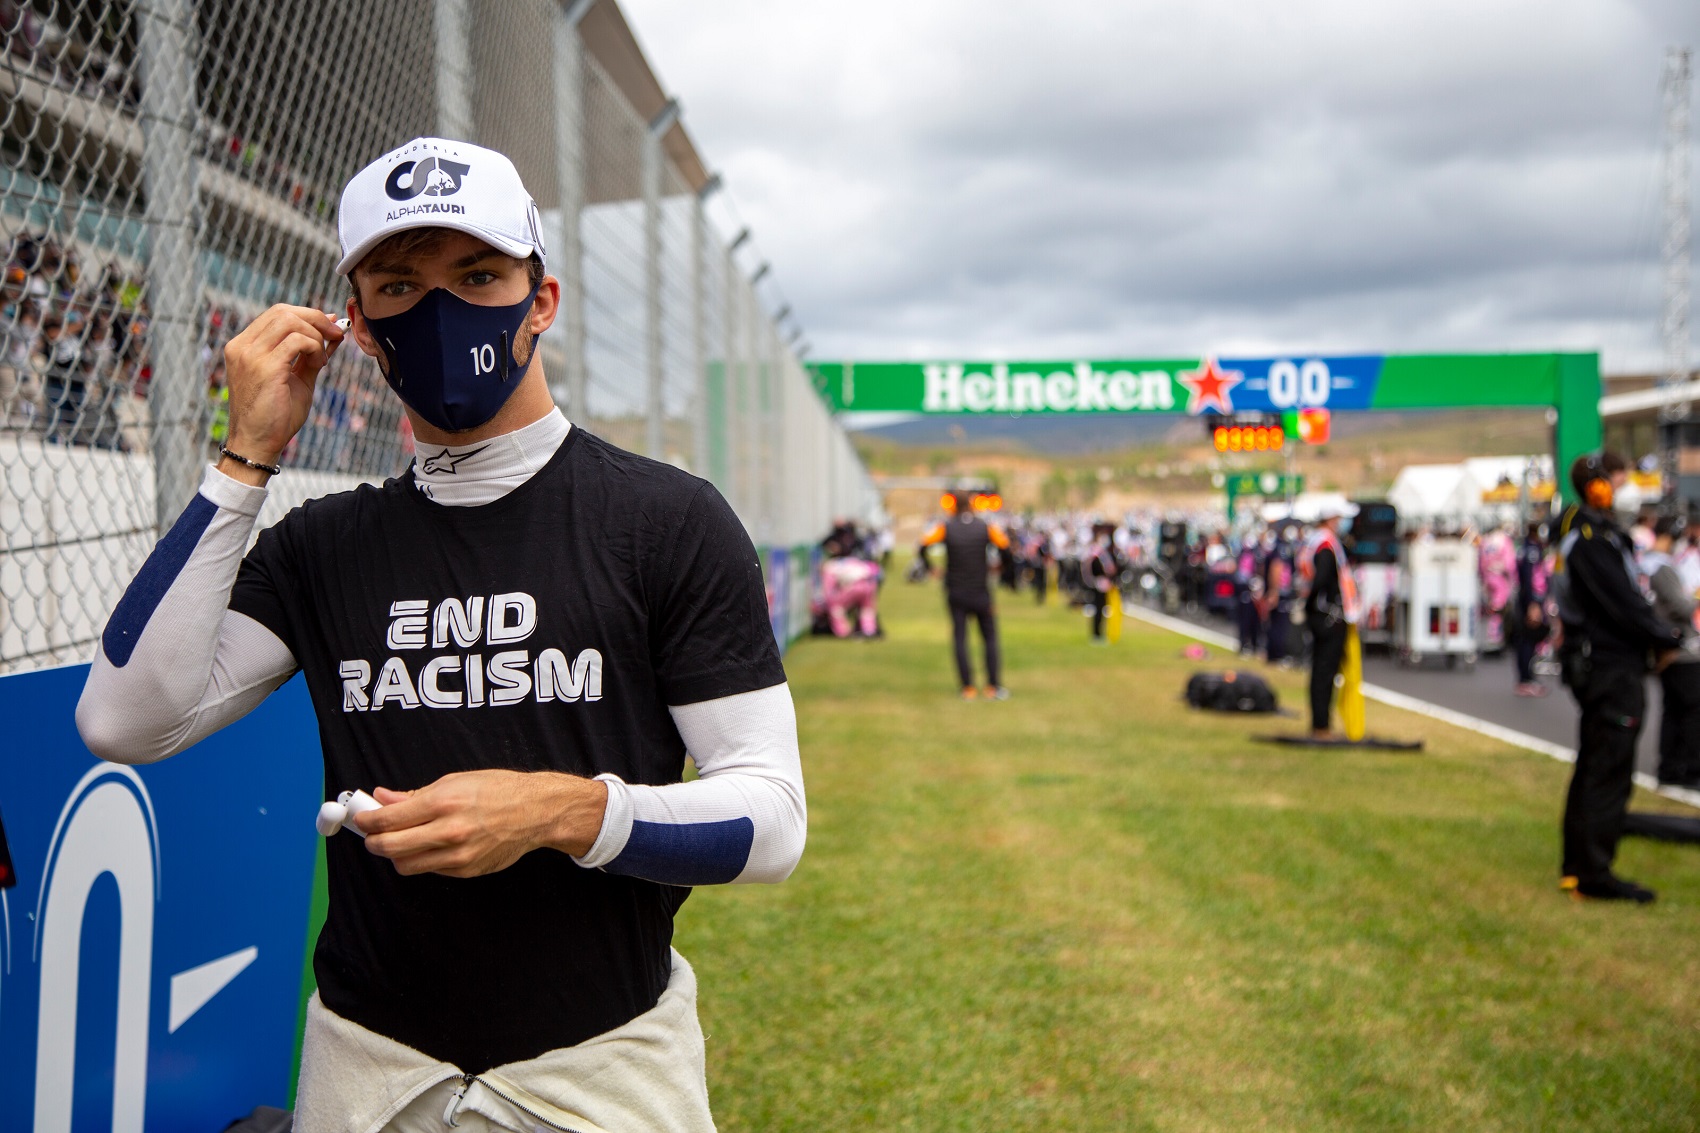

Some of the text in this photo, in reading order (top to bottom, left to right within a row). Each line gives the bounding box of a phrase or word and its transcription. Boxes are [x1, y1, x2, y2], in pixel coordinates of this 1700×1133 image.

[469, 343, 496, 376] 10
[923, 362, 1174, 412] Heineken
[386, 591, 538, 650] END
[339, 647, 603, 712] RACISM
